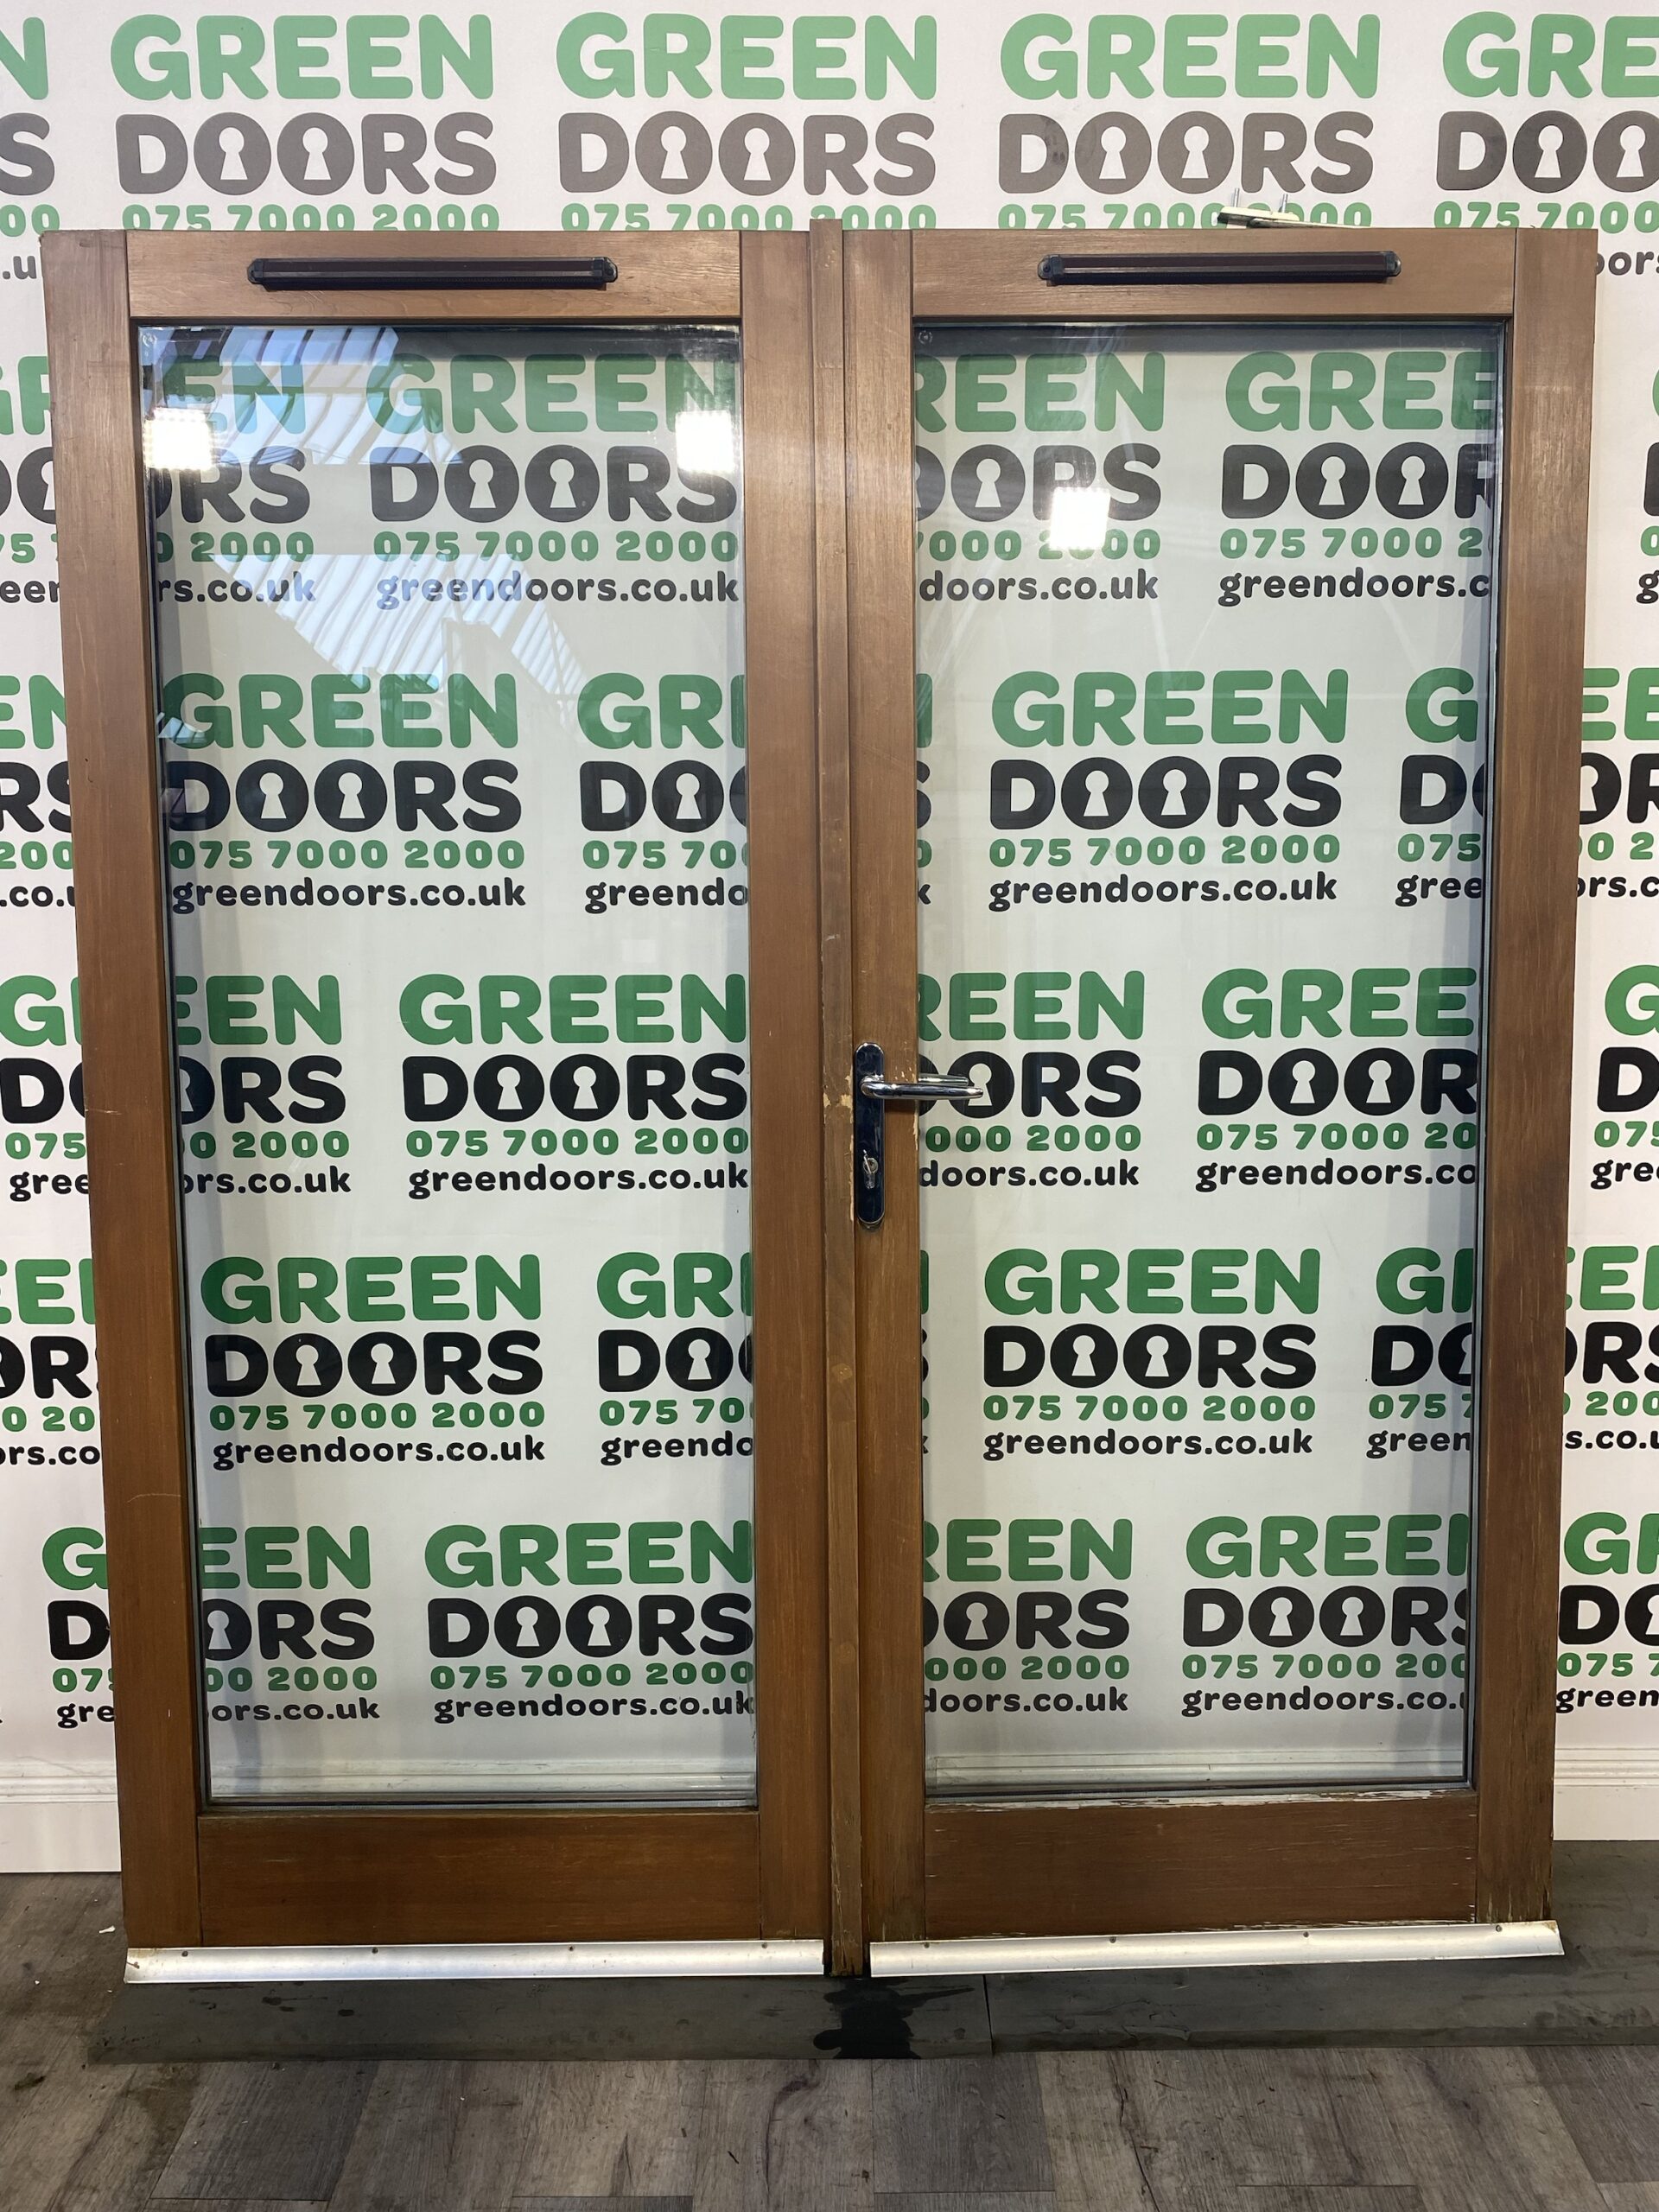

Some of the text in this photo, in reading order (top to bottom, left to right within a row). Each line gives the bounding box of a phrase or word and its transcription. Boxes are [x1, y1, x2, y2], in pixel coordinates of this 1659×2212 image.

[110, 14, 494, 101] GREEN
[556, 12, 937, 101] GREEN
[1000, 14, 1381, 100] GREEN
[115, 112, 498, 195] DOORS
[558, 111, 936, 196] DOORS
[999, 111, 1374, 194] DOORS
[123, 204, 500, 232] 075 7000 2000
[561, 203, 650, 231] 075
[667, 203, 793, 231] 7000
[998, 203, 1086, 229] 075
[1433, 200, 1521, 229] 075
[365, 353, 737, 434] GREEN
[370, 444, 738, 524] DOORS
[191, 531, 315, 563] 2000
[374, 530, 738, 563] 075 7000 2000
[917, 530, 1022, 562] 000
[1220, 528, 1306, 559] 075
[1322, 527, 1442, 558] 7000
[377, 570, 740, 610] greendoors.co.uk
[162, 672, 518, 749] GREEN
[991, 669, 1349, 748] GREEN
[166, 759, 522, 833] DOORS
[989, 753, 1343, 830] DOORS
[169, 839, 525, 870] 075 7000 2000
[582, 840, 666, 869] 075
[988, 833, 1340, 868] 075 7000 2000
[1397, 832, 1481, 862] 075
[173, 877, 526, 914] greendoors.co.uk
[988, 871, 1337, 912] greendoors.co.uk
[398, 973, 747, 1046] GREEN
[918, 970, 1145, 1041] EEN
[402, 1052, 747, 1122] DOORS
[918, 1050, 1142, 1118] ORS
[5, 1132, 86, 1160] 075
[232, 1130, 350, 1159] 2000
[405, 1127, 749, 1157] 075 7000 2000
[1026, 1124, 1141, 1153] 2000
[1196, 1123, 1278, 1151] 075
[1294, 1122, 1410, 1151] 7000
[409, 1161, 749, 1200] greendoors.co.uk
[200, 1254, 542, 1325] GREEN
[984, 1248, 1320, 1316] GREEN
[205, 1330, 543, 1398] DOORS
[983, 1324, 1317, 1389] DOORS
[209, 1401, 546, 1431] 075 7000 2000
[599, 1400, 678, 1427] 075
[982, 1395, 1316, 1422] 075 7000 2000
[1368, 1393, 1446, 1420] 075
[213, 1434, 545, 1471] greendoors.co.uk
[982, 1427, 1313, 1461] greendoors.co.uk
[424, 1520, 753, 1588] GREEN
[923, 1518, 1133, 1583] EEN
[428, 1592, 753, 1659] DOORS
[923, 1589, 1130, 1651] ORS
[52, 1668, 114, 1693] 07
[267, 1666, 378, 1692] 2000
[430, 1661, 754, 1691] 075 7000 2000
[1020, 1654, 1130, 1680] 2000
[1182, 1654, 1258, 1679] 075
[1272, 1653, 1381, 1679] 7000
[1557, 1652, 1633, 1677] 075
[434, 1688, 754, 1726] greendoors.co.uk
[1181, 1686, 1465, 1718] greendoors.co.
